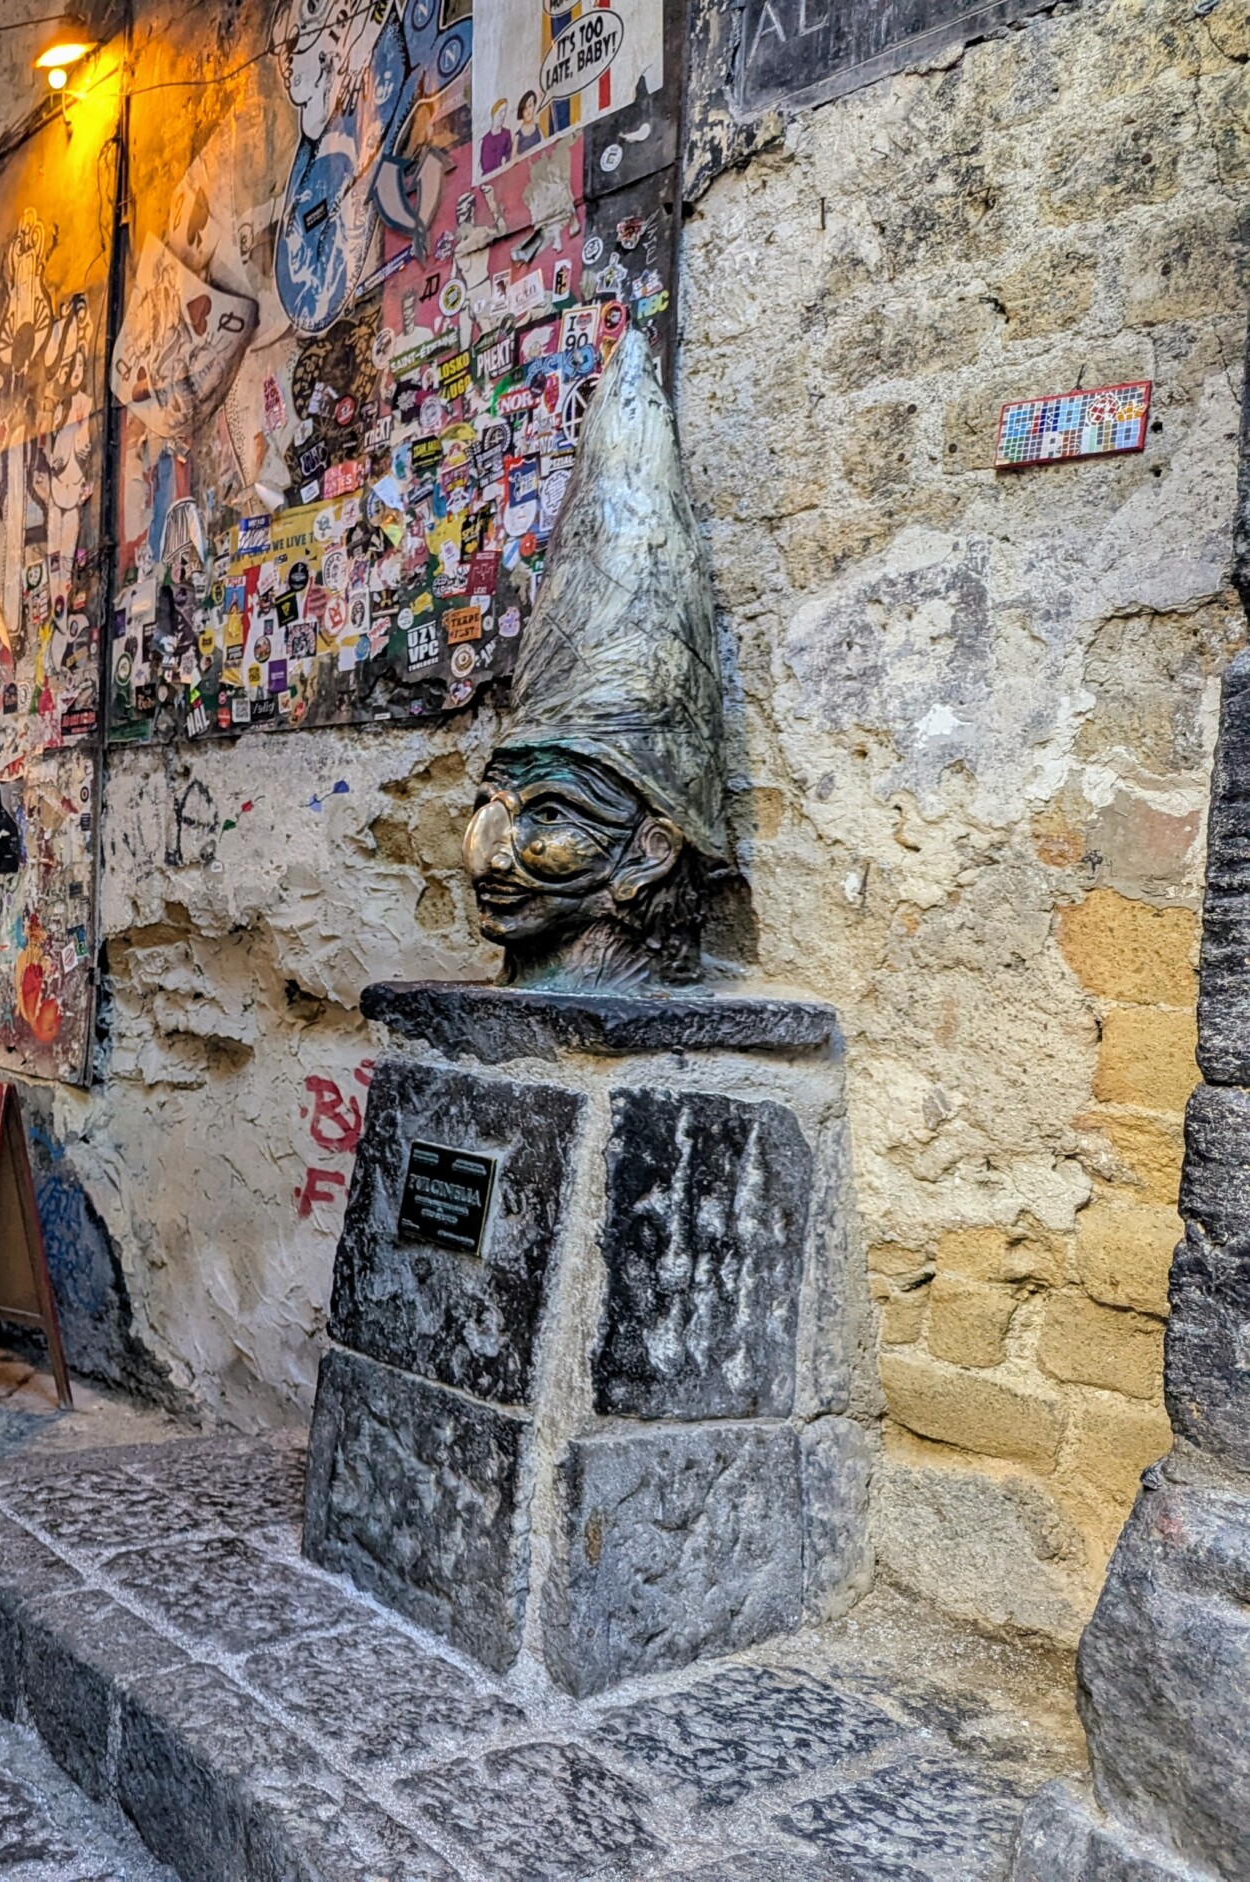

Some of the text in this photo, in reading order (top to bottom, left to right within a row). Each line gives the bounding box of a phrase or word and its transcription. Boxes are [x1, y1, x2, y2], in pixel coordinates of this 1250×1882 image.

[557, 15, 603, 61] IT'S TOO
[546, 31, 617, 90] LATE, BABY!
[272, 539, 284, 552] WE
[287, 533, 306, 548] LIVE
[408, 624, 437, 648] UZY
[408, 640, 439, 664] VPC
